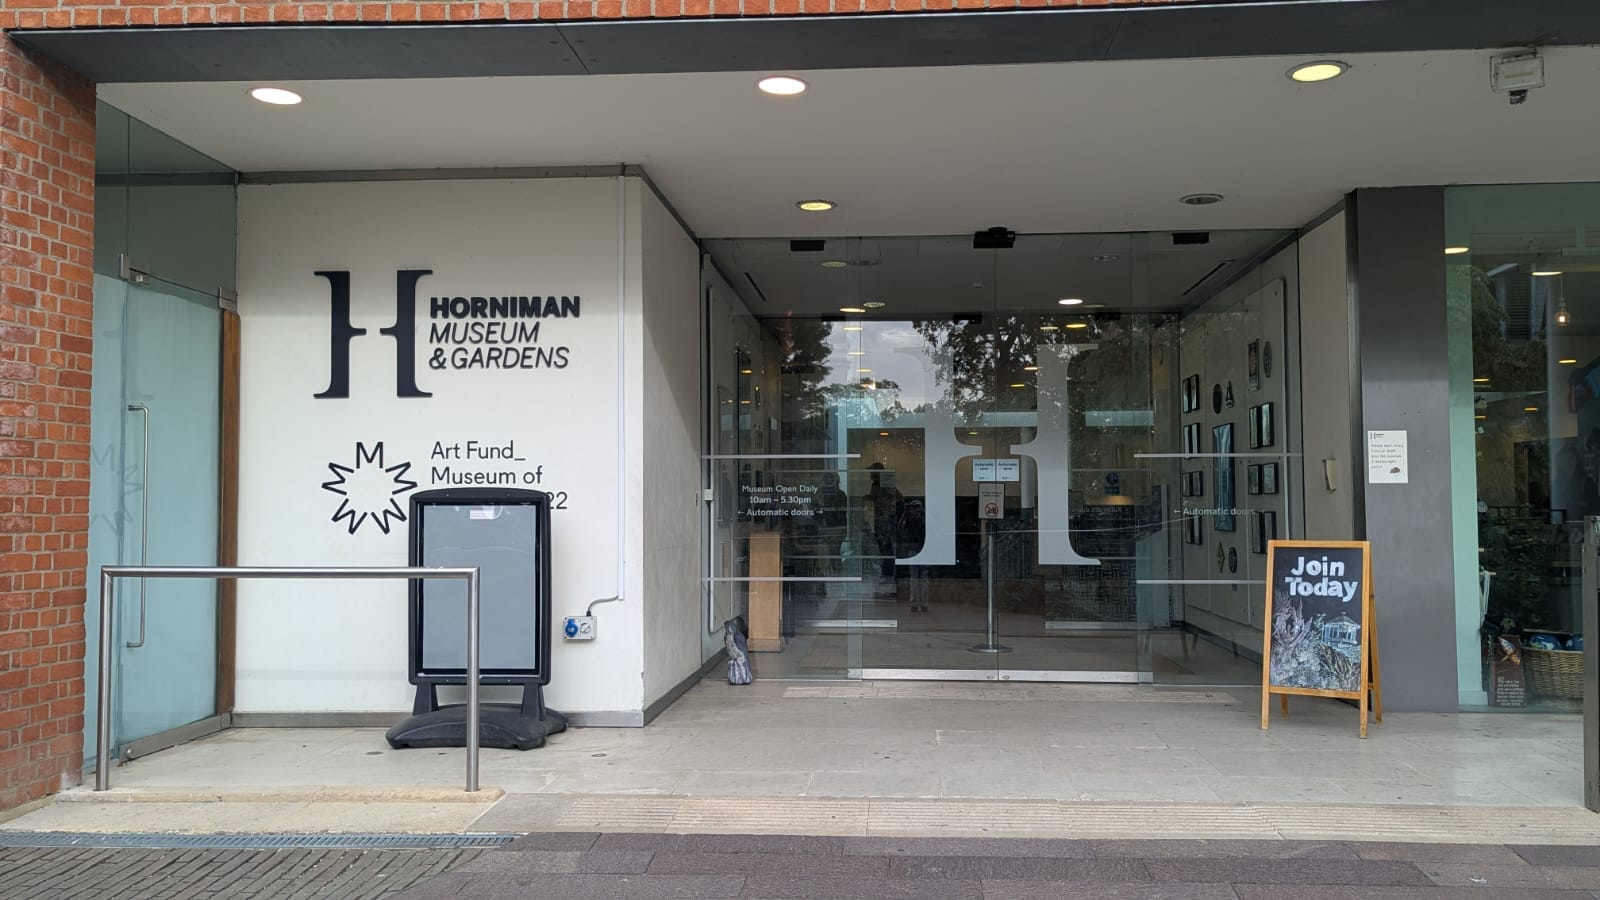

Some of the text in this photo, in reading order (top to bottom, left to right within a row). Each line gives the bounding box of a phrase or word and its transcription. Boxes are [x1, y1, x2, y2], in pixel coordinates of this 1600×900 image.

[430, 296, 580, 319] HORNIMAN
[429, 321, 540, 344] MUSEUM
[431, 440, 460, 459] Art
[431, 465, 543, 485] Museum of
[742, 485, 773, 493] Museum
[775, 485, 797, 495] Open
[799, 485, 818, 495] Daily
[750, 496, 772, 504] 10am
[780, 496, 812, 505] 5.30pm
[746, 507, 789, 516] Automatic
[790, 507, 815, 516] doors
[1183, 507, 1229, 516] Automatic
[1285, 556, 1358, 602] Join Today
